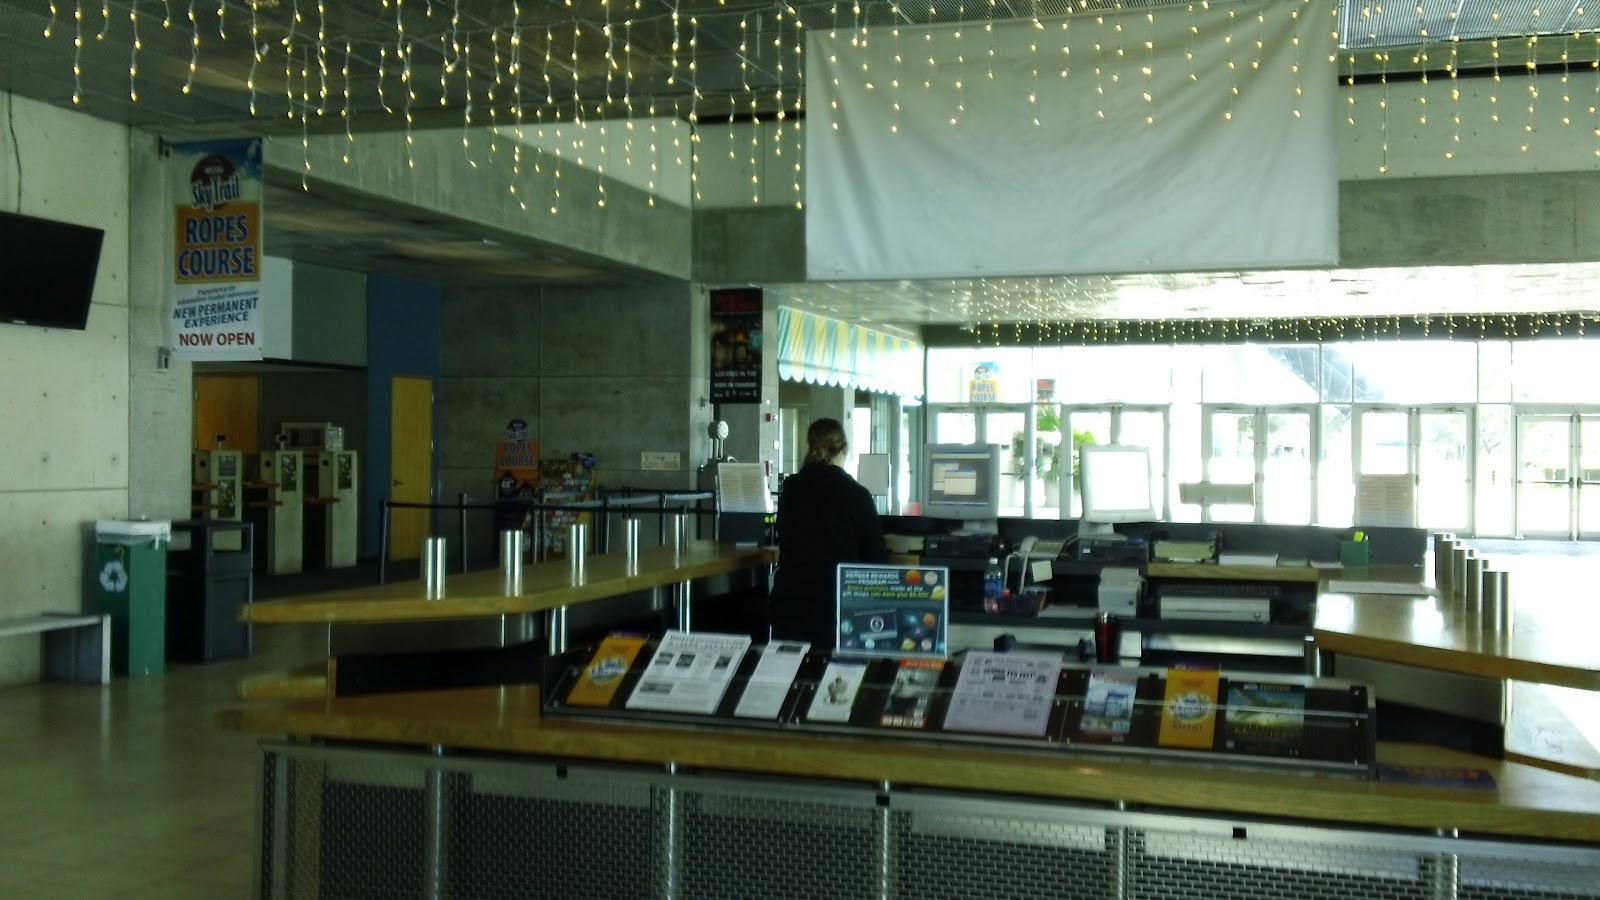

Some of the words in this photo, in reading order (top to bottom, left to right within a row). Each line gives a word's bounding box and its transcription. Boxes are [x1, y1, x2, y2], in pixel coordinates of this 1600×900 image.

[192, 178, 213, 211] Sky
[210, 172, 241, 203] Trail
[185, 215, 248, 245] ROPES
[178, 247, 254, 277] COURSE
[173, 306, 197, 320] NEW
[197, 297, 259, 316] PERMANENT
[184, 311, 249, 328] EXPERIENCE
[179, 333, 213, 346] NOW
[216, 332, 255, 346] OPEN
[972, 383, 994, 392] ROPES
[970, 393, 996, 402] COURSE
[504, 443, 533, 453] ROPES
[501, 455, 534, 466] COURSE
